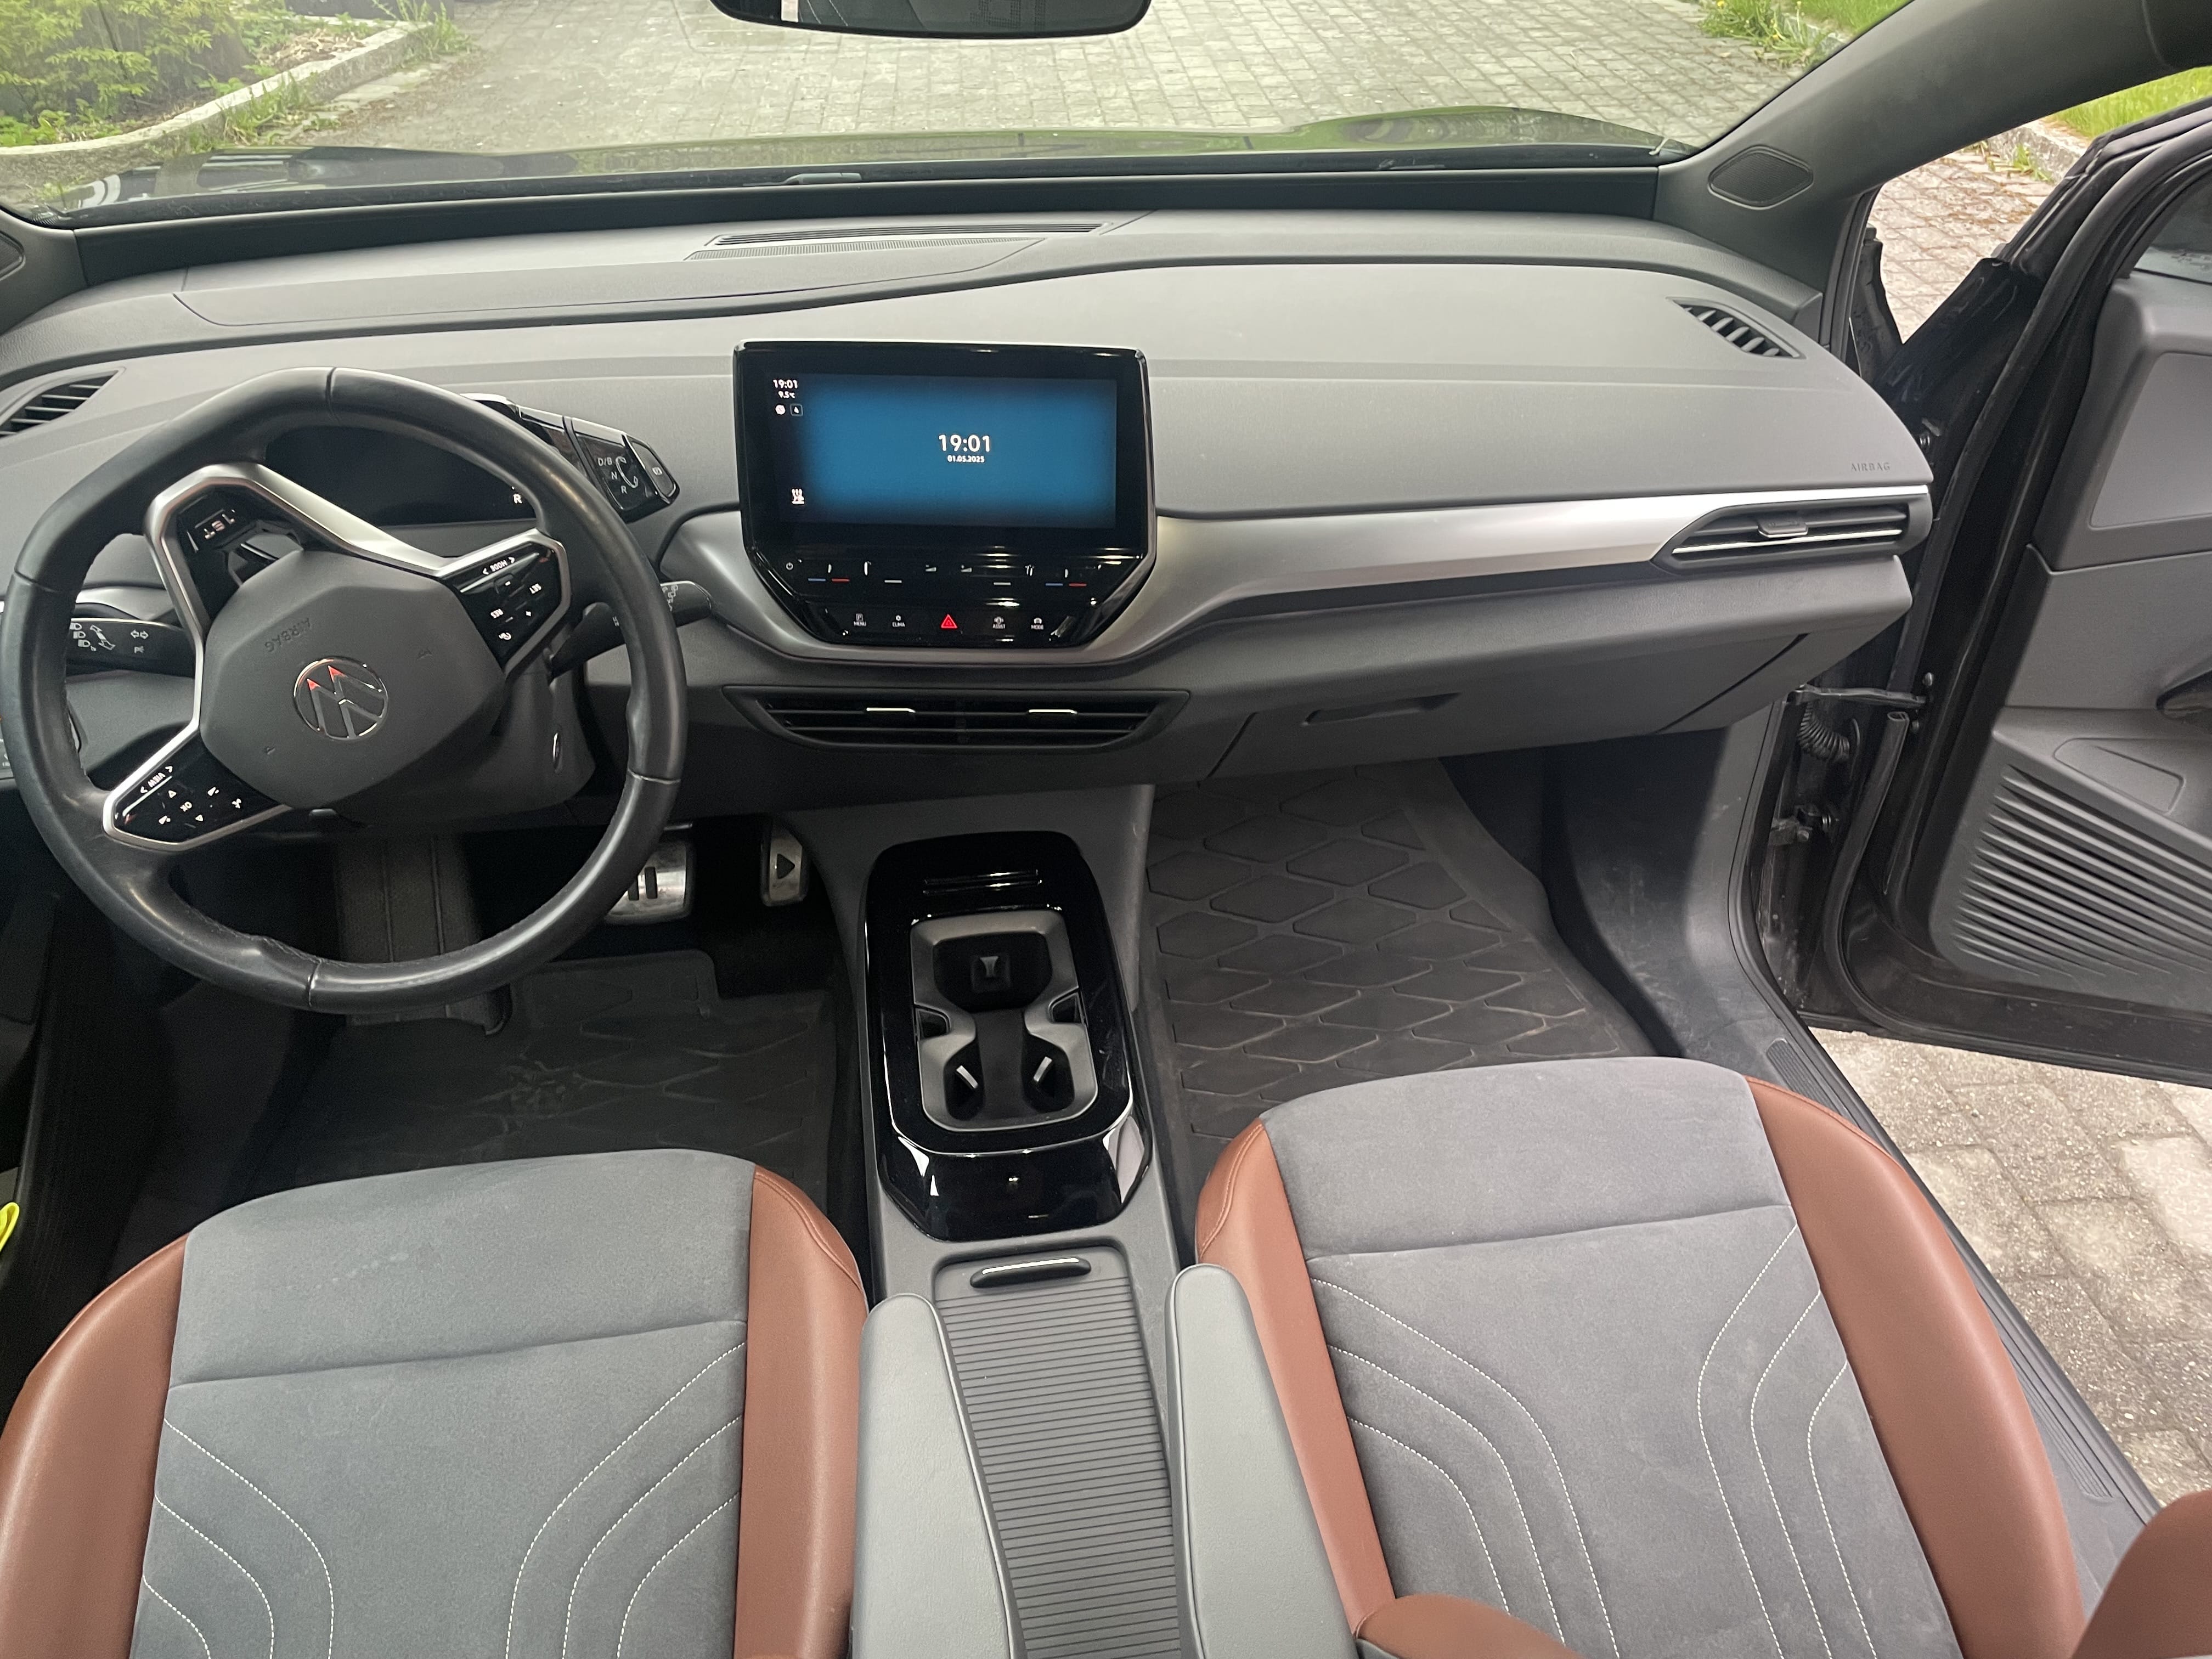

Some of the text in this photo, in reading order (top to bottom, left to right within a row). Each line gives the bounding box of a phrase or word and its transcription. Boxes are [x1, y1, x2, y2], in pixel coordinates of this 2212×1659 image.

[772, 379, 798, 389] 19:01
[938, 434, 990, 452] 19:01
[597, 456, 613, 466] D/B
[1851, 462, 1891, 472] AIRBAG
[611, 471, 618, 480] N
[620, 485, 628, 494] R
[513, 493, 523, 504] R
[489, 559, 508, 572] MODE
[529, 583, 542, 594] SET
[264, 617, 312, 653] AIRBAG
[179, 801, 193, 812] OK
